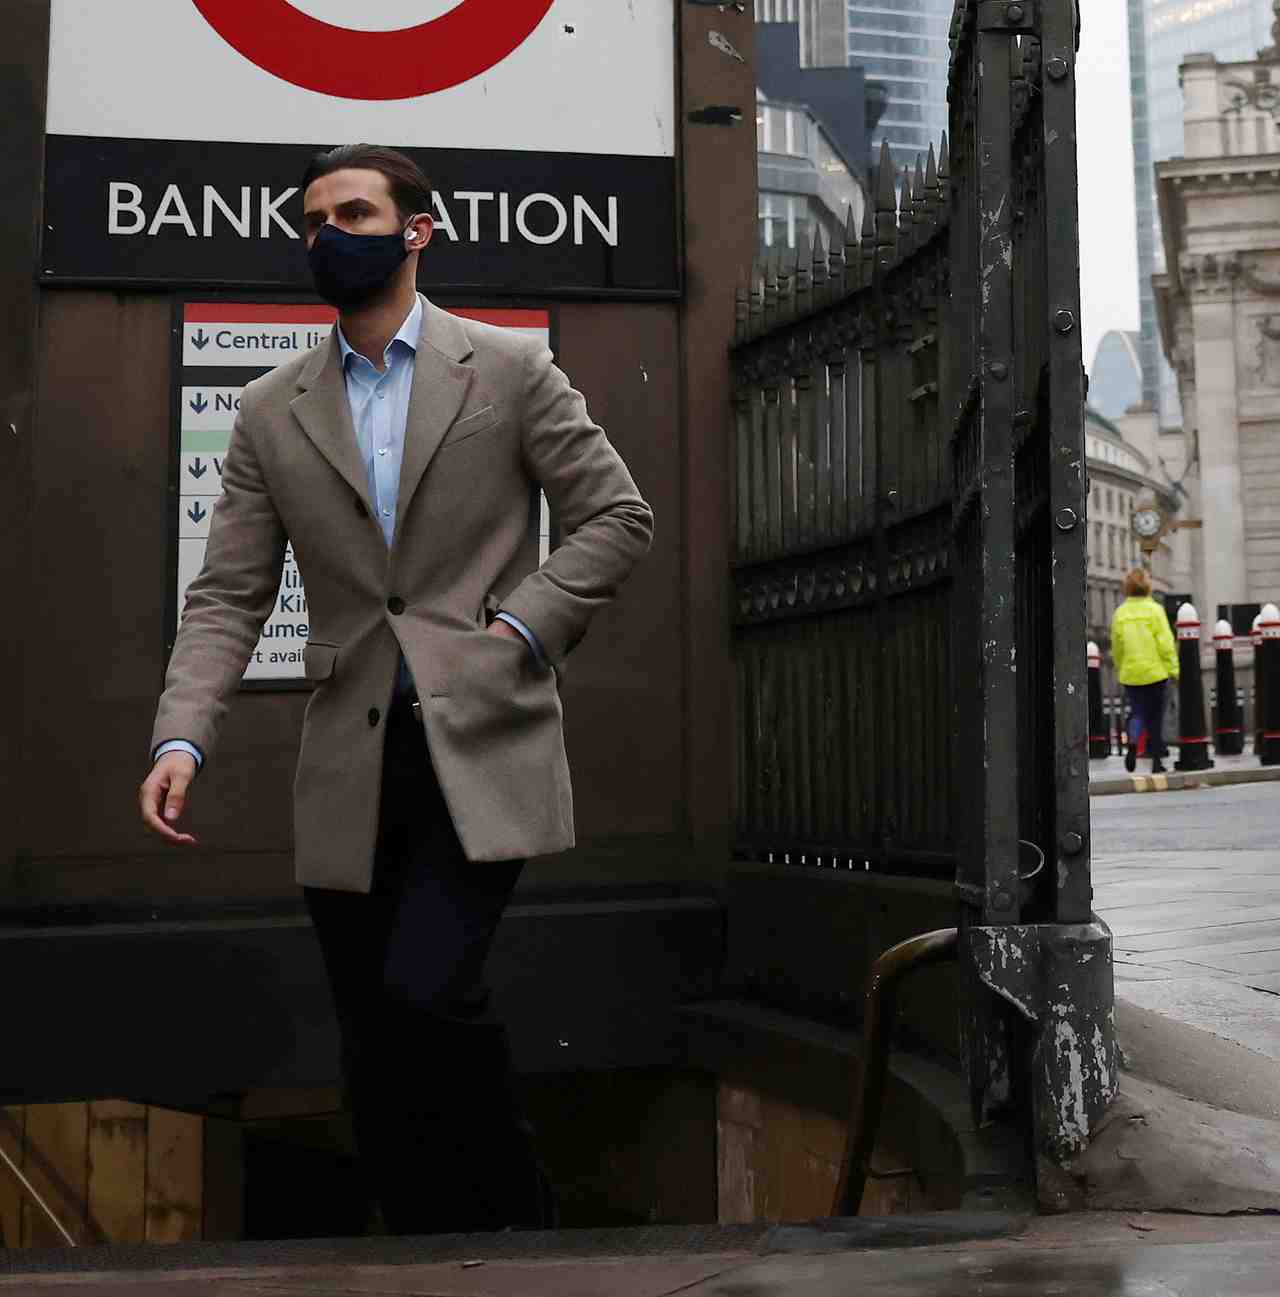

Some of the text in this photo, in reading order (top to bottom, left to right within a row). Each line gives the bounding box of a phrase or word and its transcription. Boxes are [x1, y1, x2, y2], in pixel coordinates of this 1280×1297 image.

[107, 181, 619, 247] BANK ATION
[215, 330, 299, 350] Central
[262, 623, 308, 638] ume
